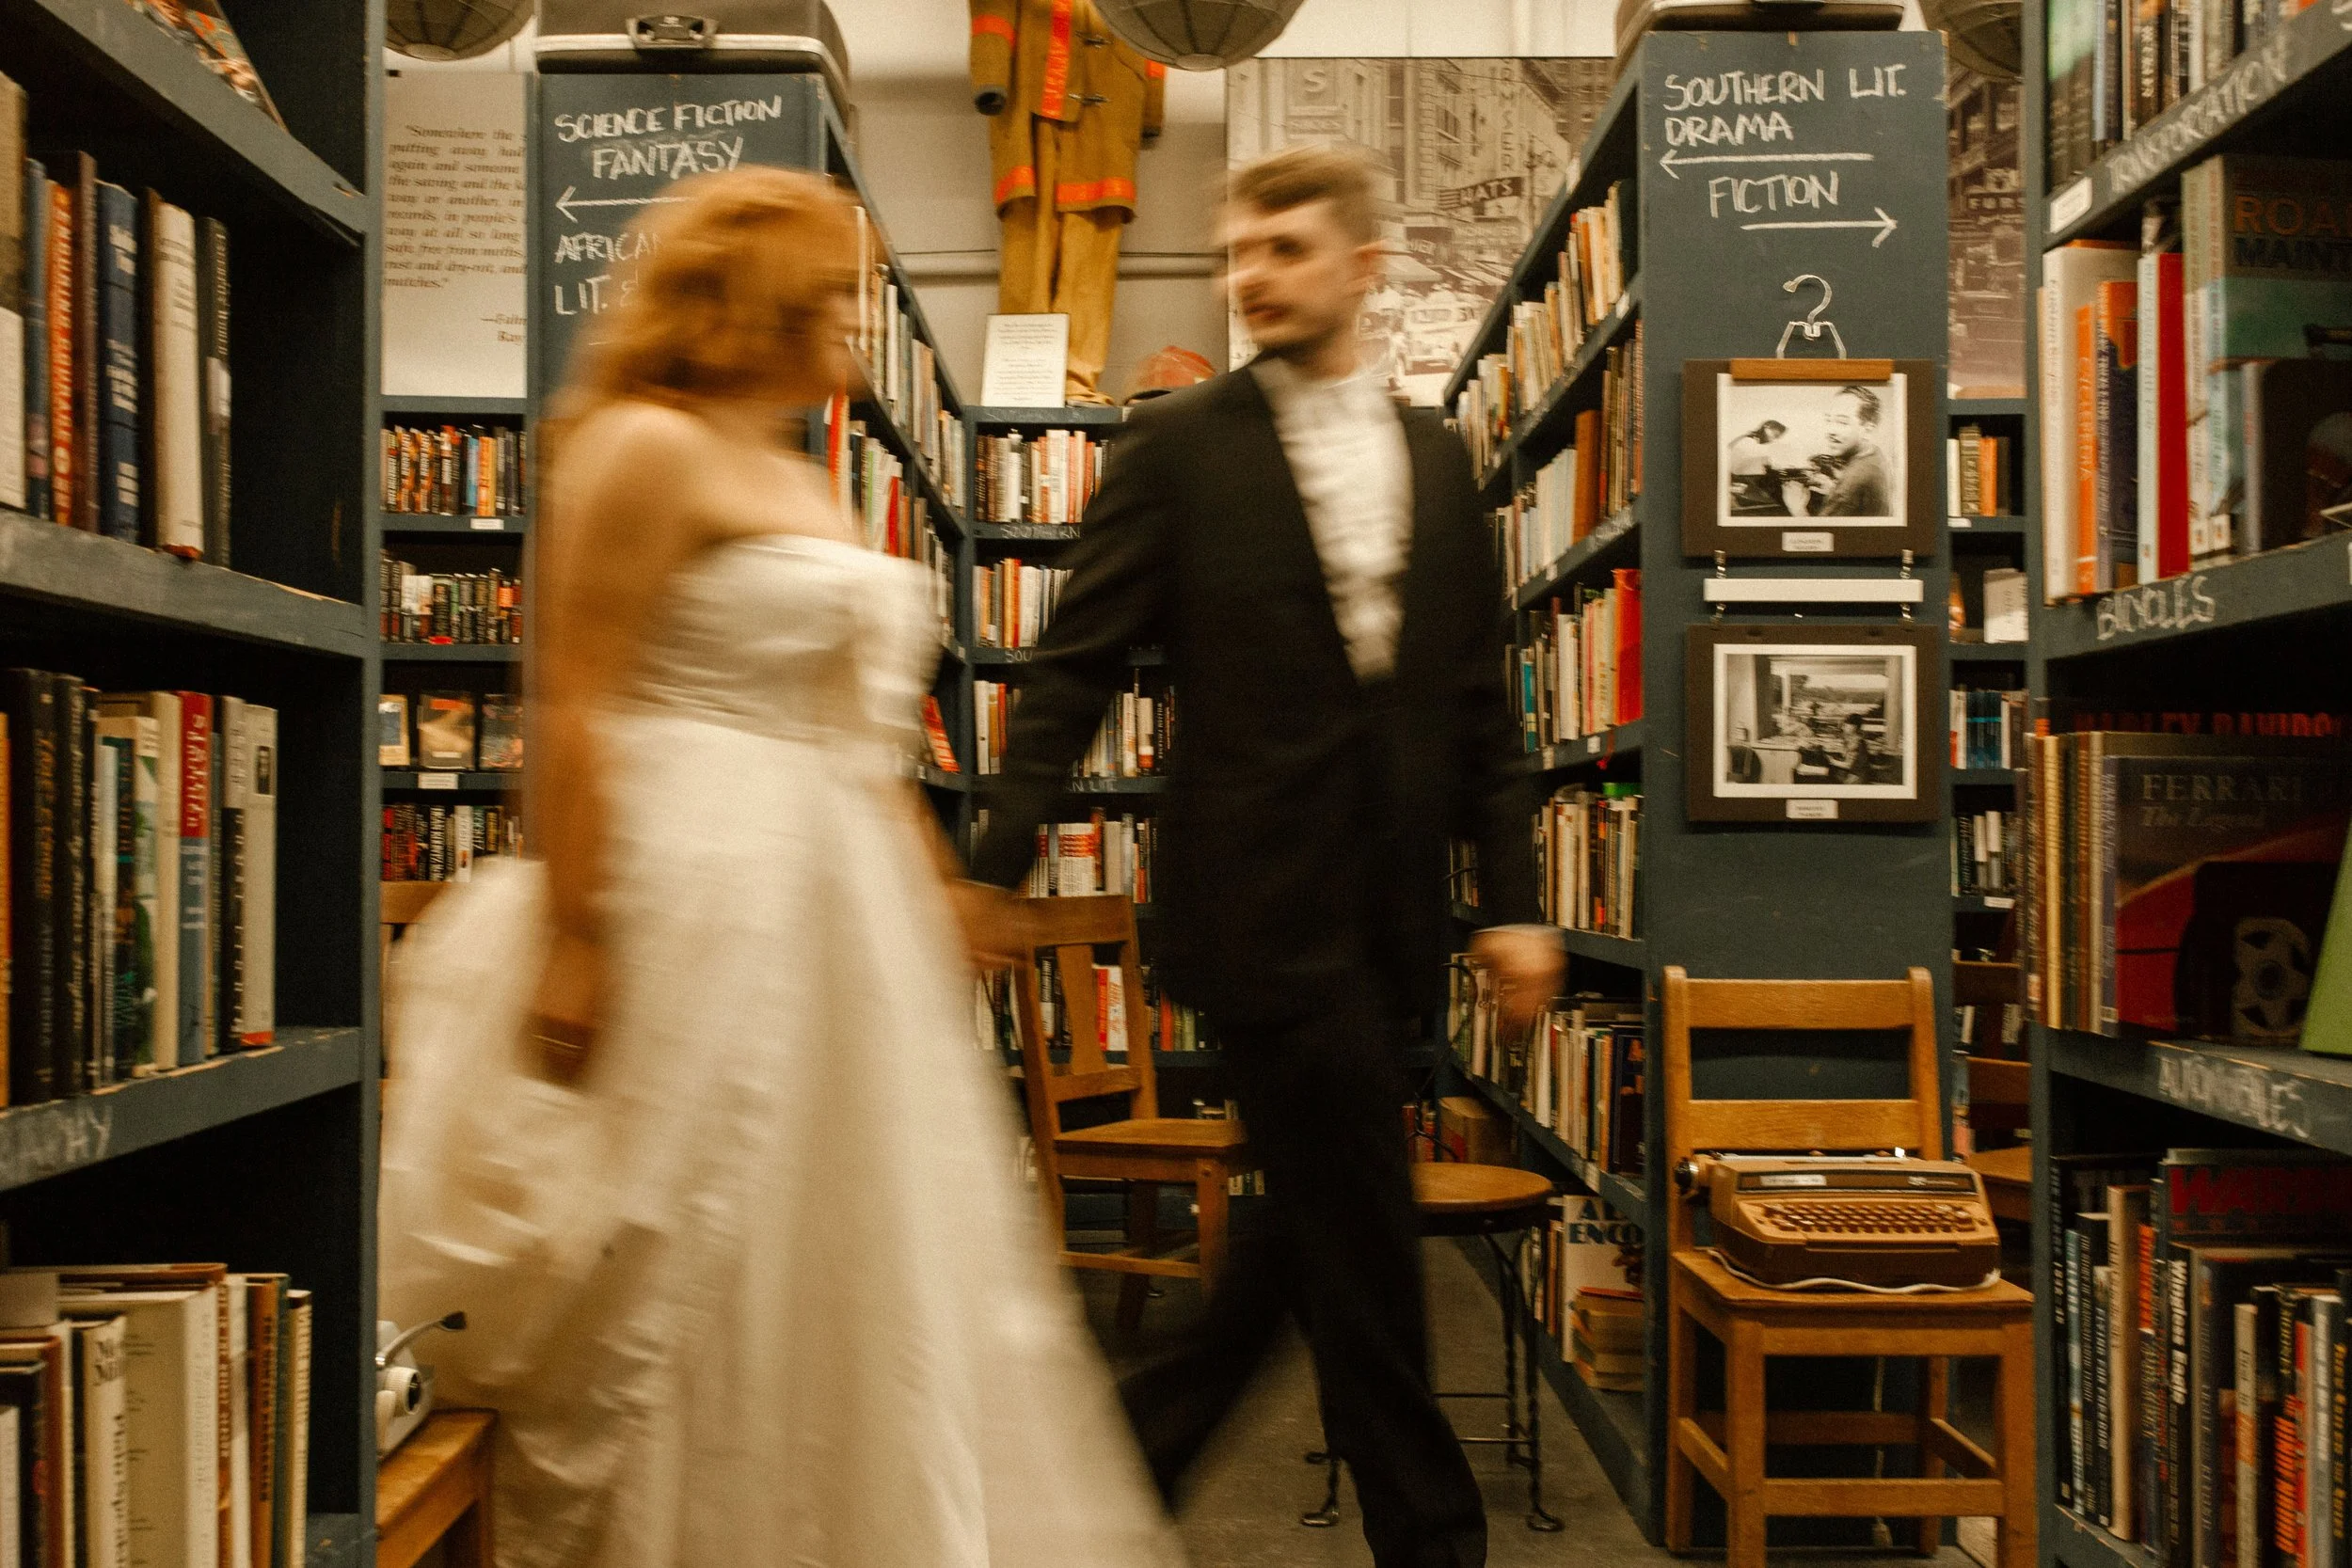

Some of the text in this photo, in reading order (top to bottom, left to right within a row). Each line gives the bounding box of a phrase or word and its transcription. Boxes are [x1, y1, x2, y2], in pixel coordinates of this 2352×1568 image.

[1663, 63, 1908, 111] SOUTHERN LIT.
[554, 94, 783, 143] SCIENCE FICTION
[1664, 110, 1795, 148] DRAMA
[591, 135, 744, 181] FANTASY
[1708, 169, 1839, 219] FICTION
[2233, 194, 2352, 237] ROA
[2095, 574, 2217, 641] BICYCLES
[2140, 772, 2304, 801] FERRARI
[2169, 1259, 2188, 1346] Wingless
[2169, 1349, 2188, 1405] Eagle
